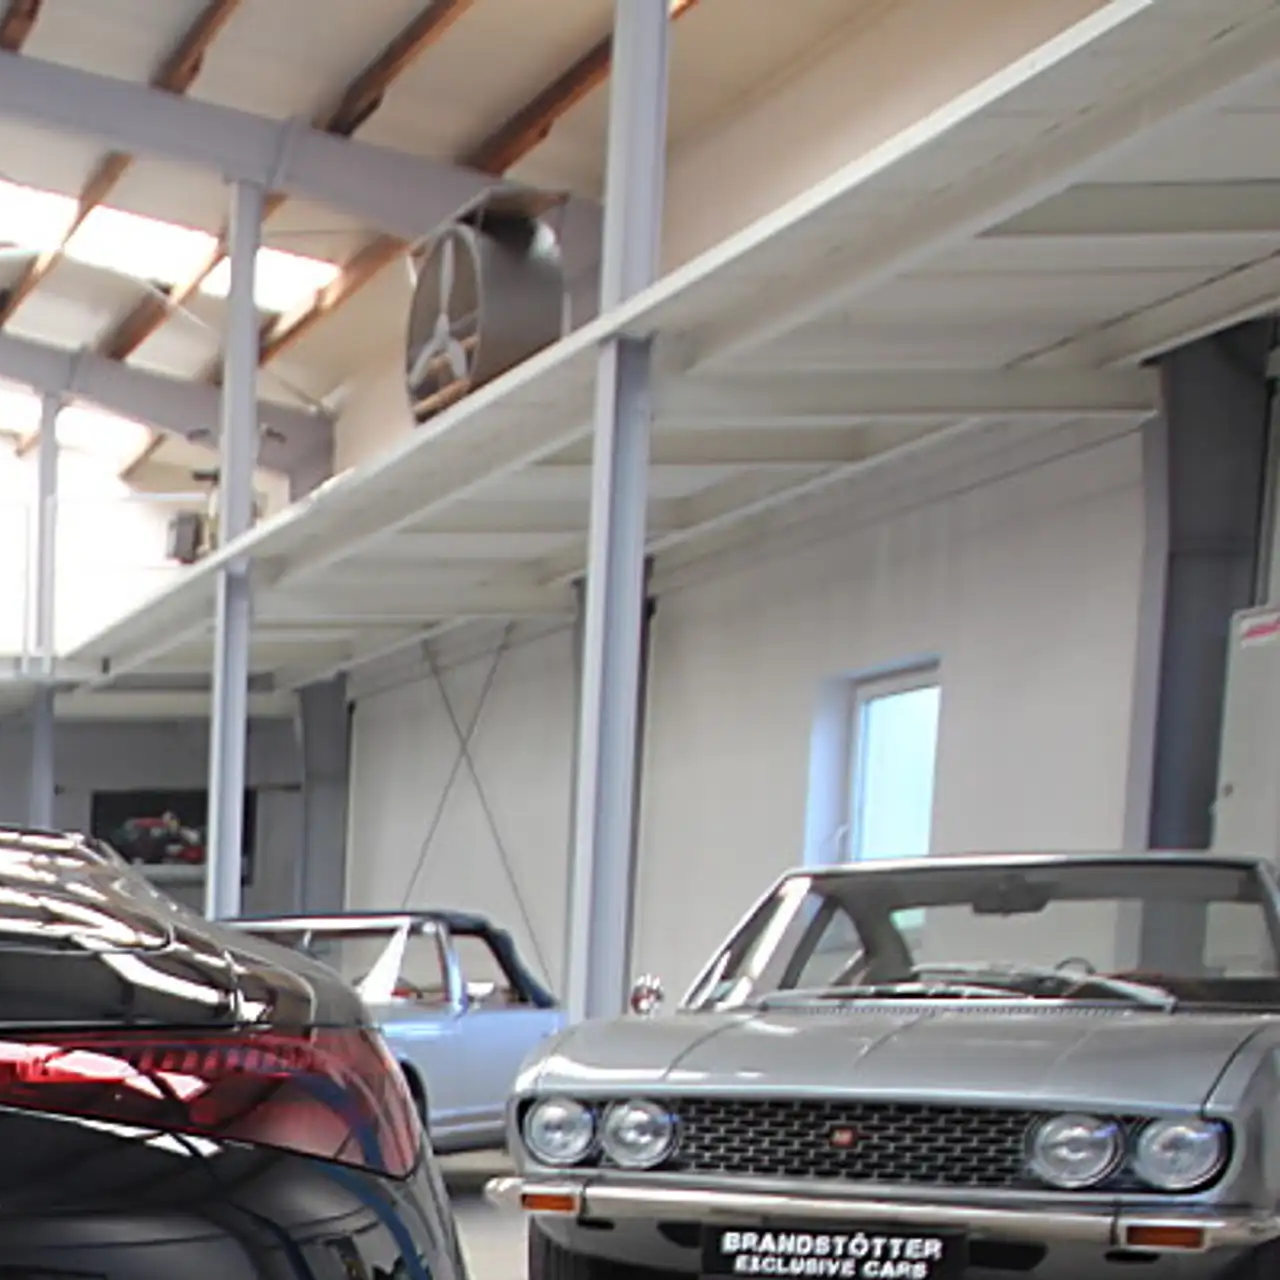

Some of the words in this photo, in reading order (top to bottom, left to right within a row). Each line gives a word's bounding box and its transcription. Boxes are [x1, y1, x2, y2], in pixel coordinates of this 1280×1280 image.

[722, 1231, 942, 1260] BRANDSTÖTTER
[734, 1254, 856, 1277] EXCLUSIVE
[862, 1260, 928, 1280] CARS
